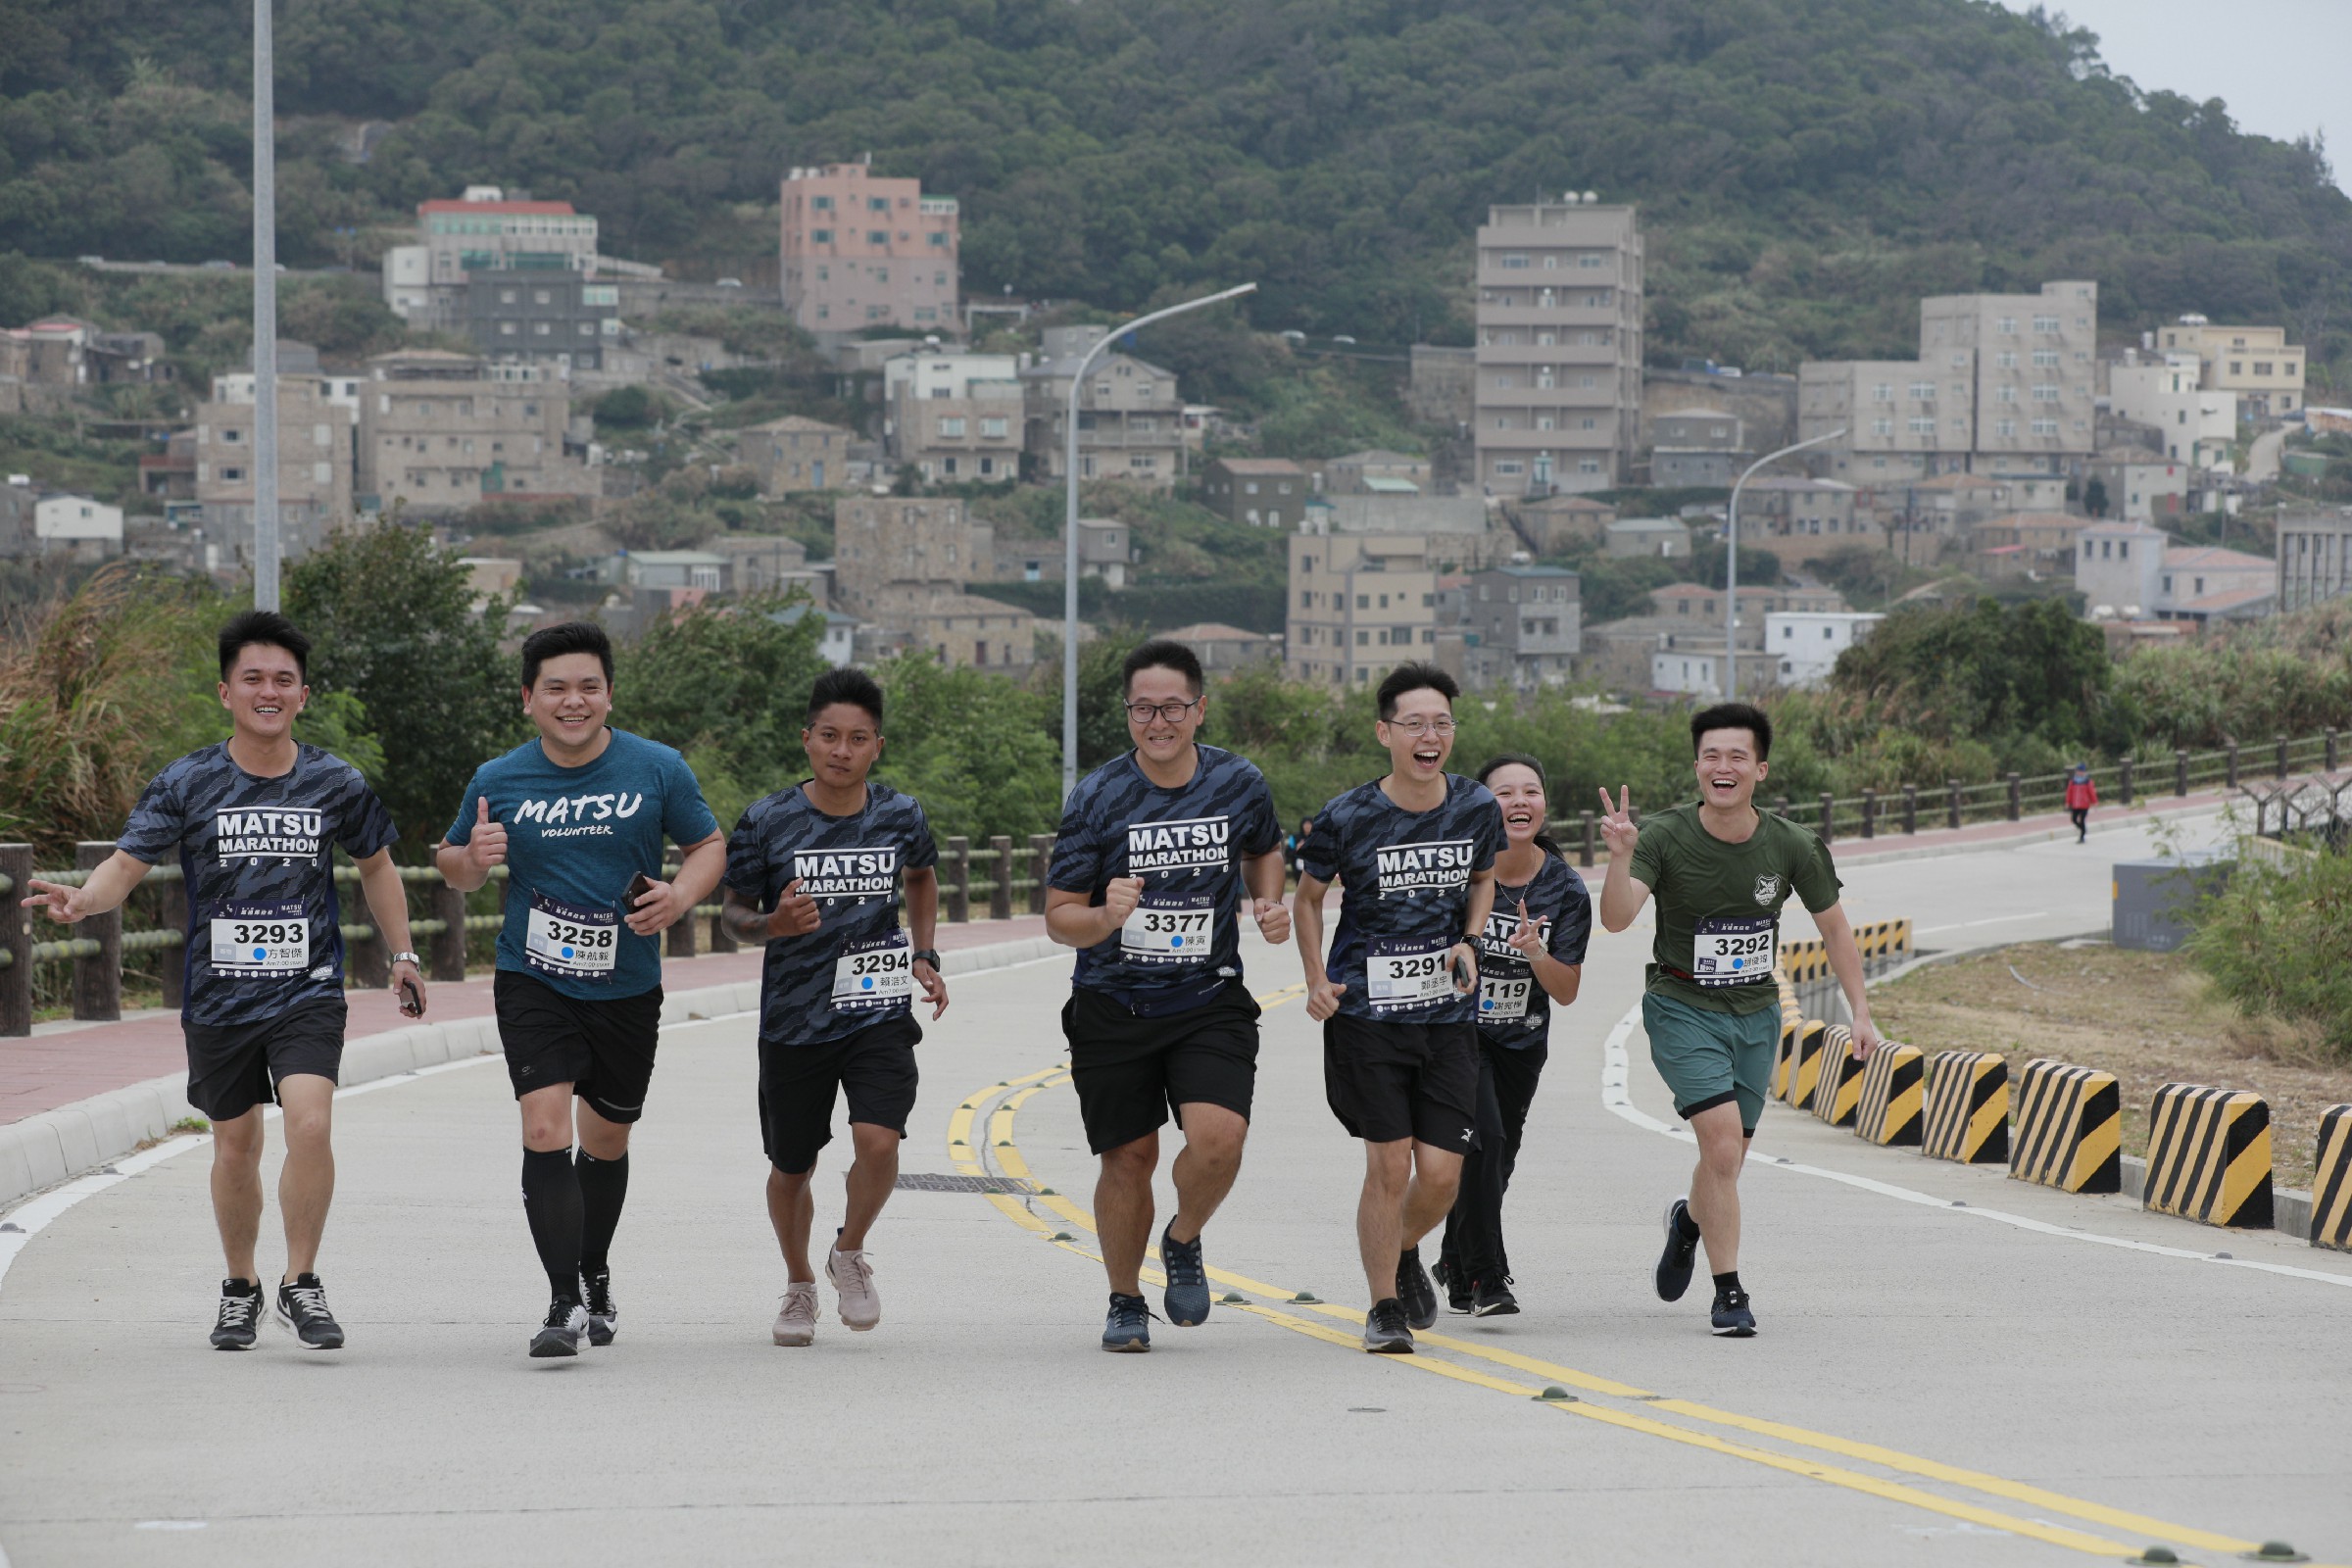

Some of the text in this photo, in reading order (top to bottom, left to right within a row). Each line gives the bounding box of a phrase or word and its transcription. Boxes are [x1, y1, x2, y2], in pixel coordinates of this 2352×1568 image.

[514, 792, 642, 825] MATSU
[218, 812, 321, 836] MATSU
[541, 824, 613, 838] VOLUNTEER
[219, 837, 318, 853] MARATHON
[1129, 822, 1229, 852] MATSU
[794, 853, 896, 878] MATSU
[1129, 846, 1228, 868] MARATHON
[1377, 845, 1473, 874] MATSU
[1379, 868, 1470, 888] MARATHON
[234, 923, 304, 944] 3293
[548, 920, 612, 948] 3258
[1145, 913, 1209, 933] 3377
[1715, 934, 1769, 956] 3292
[852, 951, 909, 975] 3294
[1389, 954, 1446, 979] 3291
[1480, 982, 1527, 999] 119
